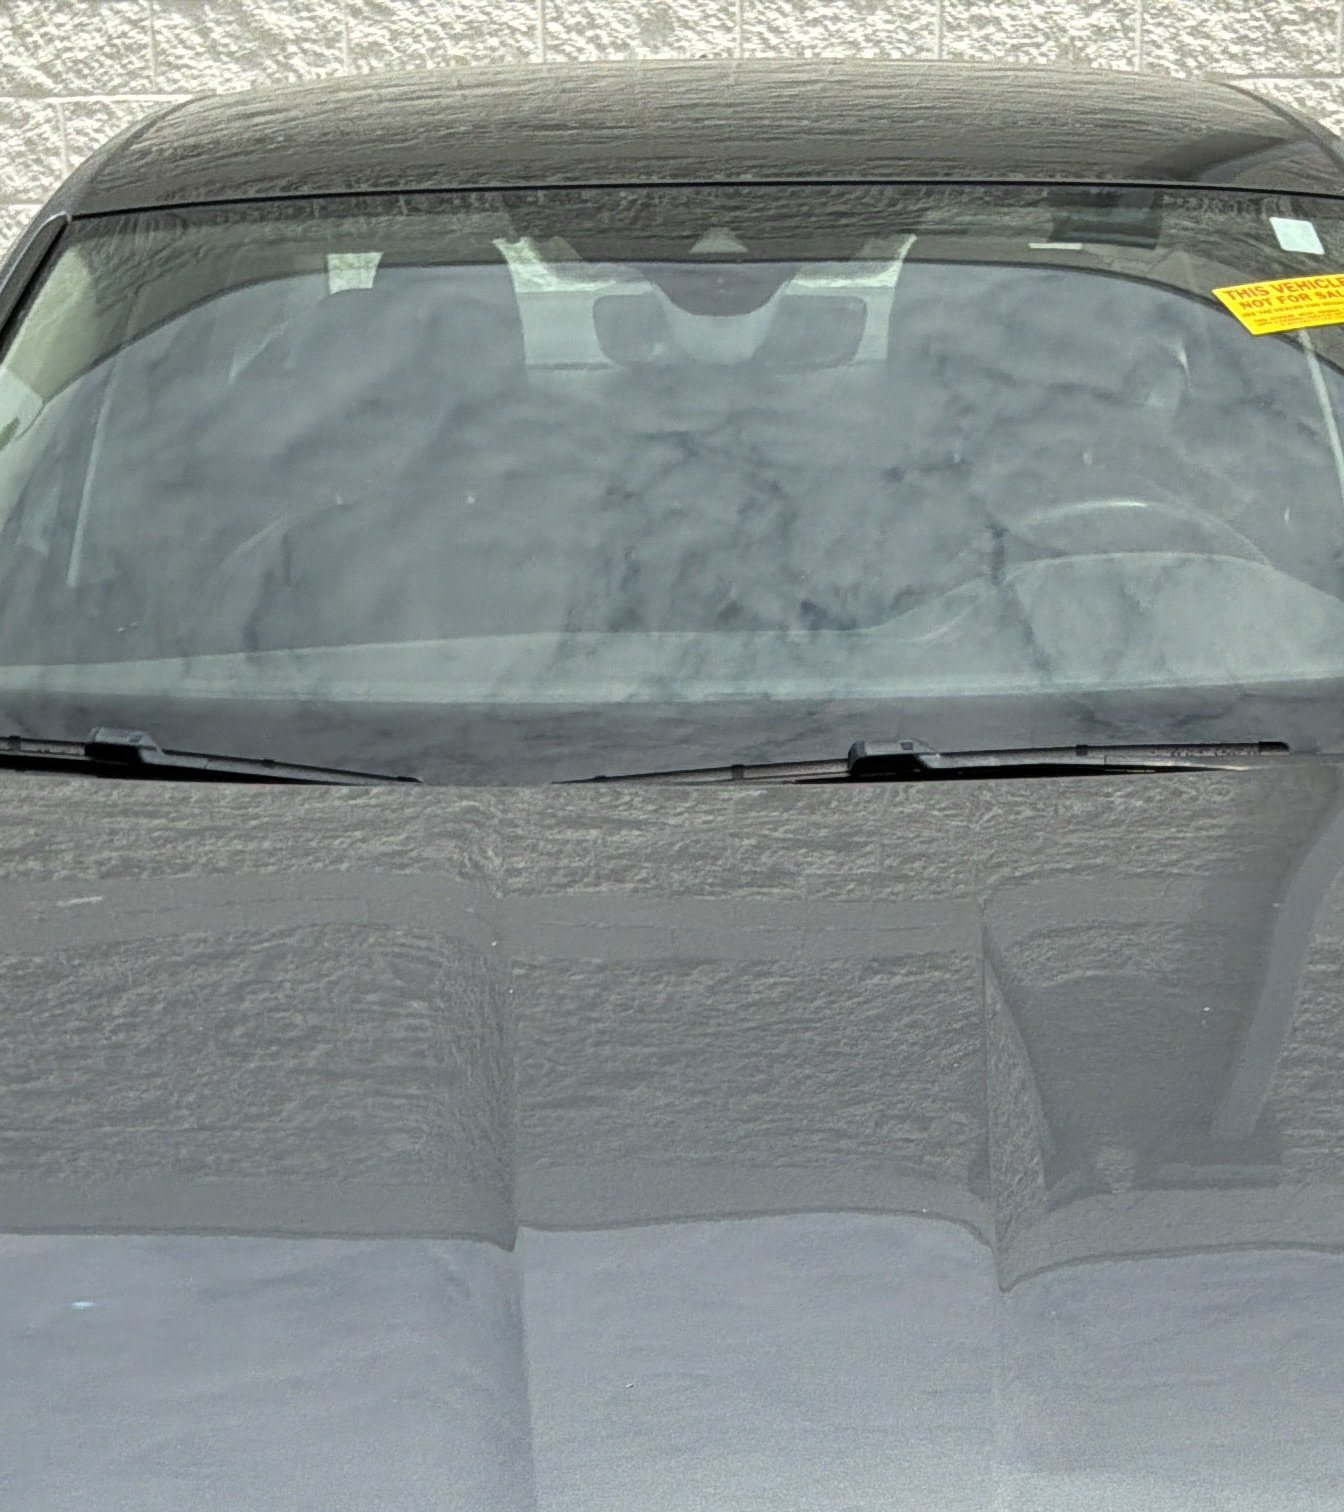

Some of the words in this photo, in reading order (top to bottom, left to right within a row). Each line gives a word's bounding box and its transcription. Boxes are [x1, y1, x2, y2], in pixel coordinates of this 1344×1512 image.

[1222, 285, 1270, 301] THIS
[1239, 298, 1273, 310] NOT
[1275, 293, 1313, 304] FOR
